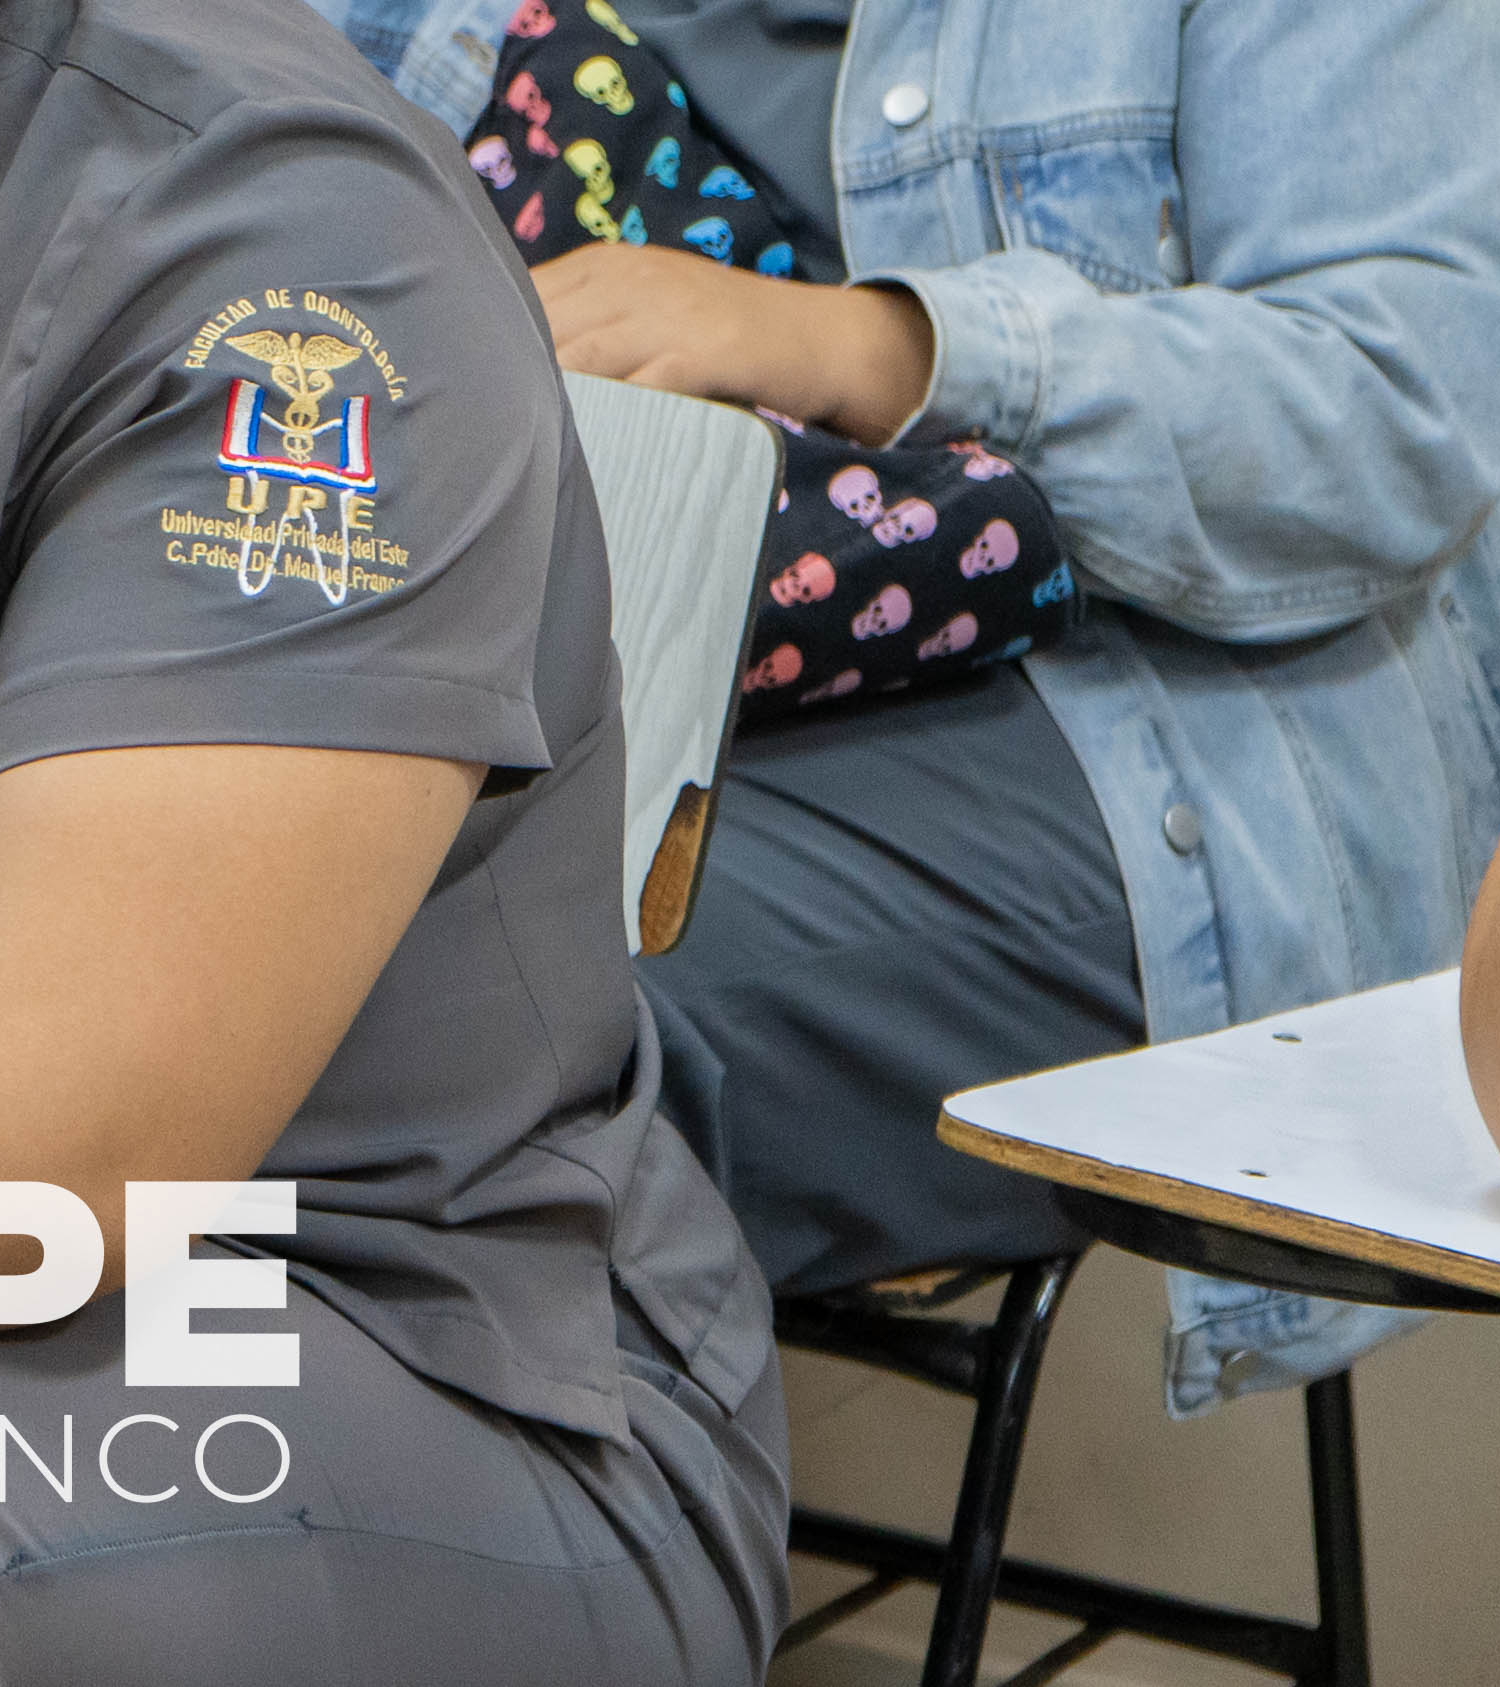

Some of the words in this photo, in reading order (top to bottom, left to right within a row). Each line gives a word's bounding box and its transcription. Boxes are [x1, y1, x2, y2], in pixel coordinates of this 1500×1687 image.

[184, 297, 257, 369] FACULTAD
[264, 288, 295, 310] DE
[303, 290, 409, 402] ODONTOLOGÍA
[226, 476, 376, 533] UPE
[161, 508, 276, 545] Universidad
[281, 522, 347, 556] Privada
[351, 535, 376, 562] del
